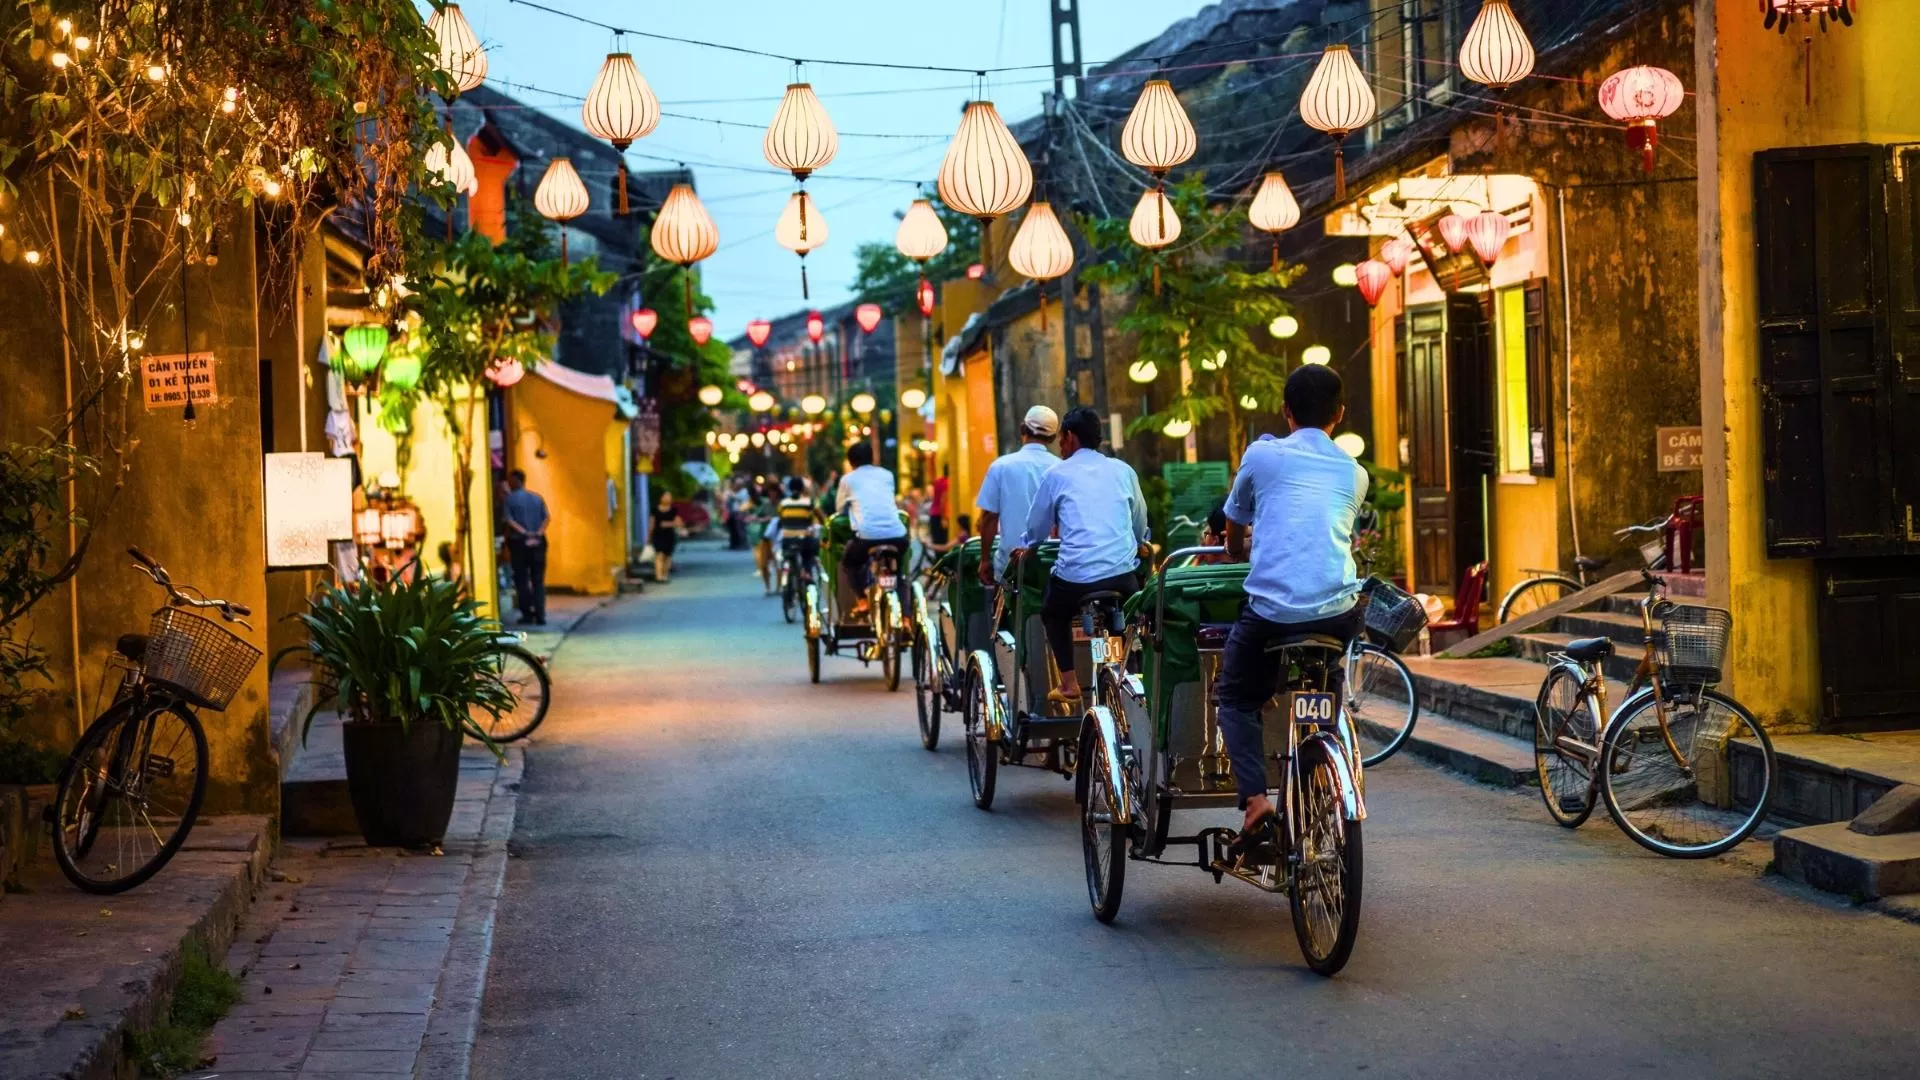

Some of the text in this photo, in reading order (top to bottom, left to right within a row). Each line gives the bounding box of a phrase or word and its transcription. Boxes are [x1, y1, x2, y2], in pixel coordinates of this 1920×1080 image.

[149, 378, 161, 388] 01
[1668, 431, 1702, 447] CẤM
[1093, 641, 1121, 659] 101
[1295, 697, 1332, 720] 040
